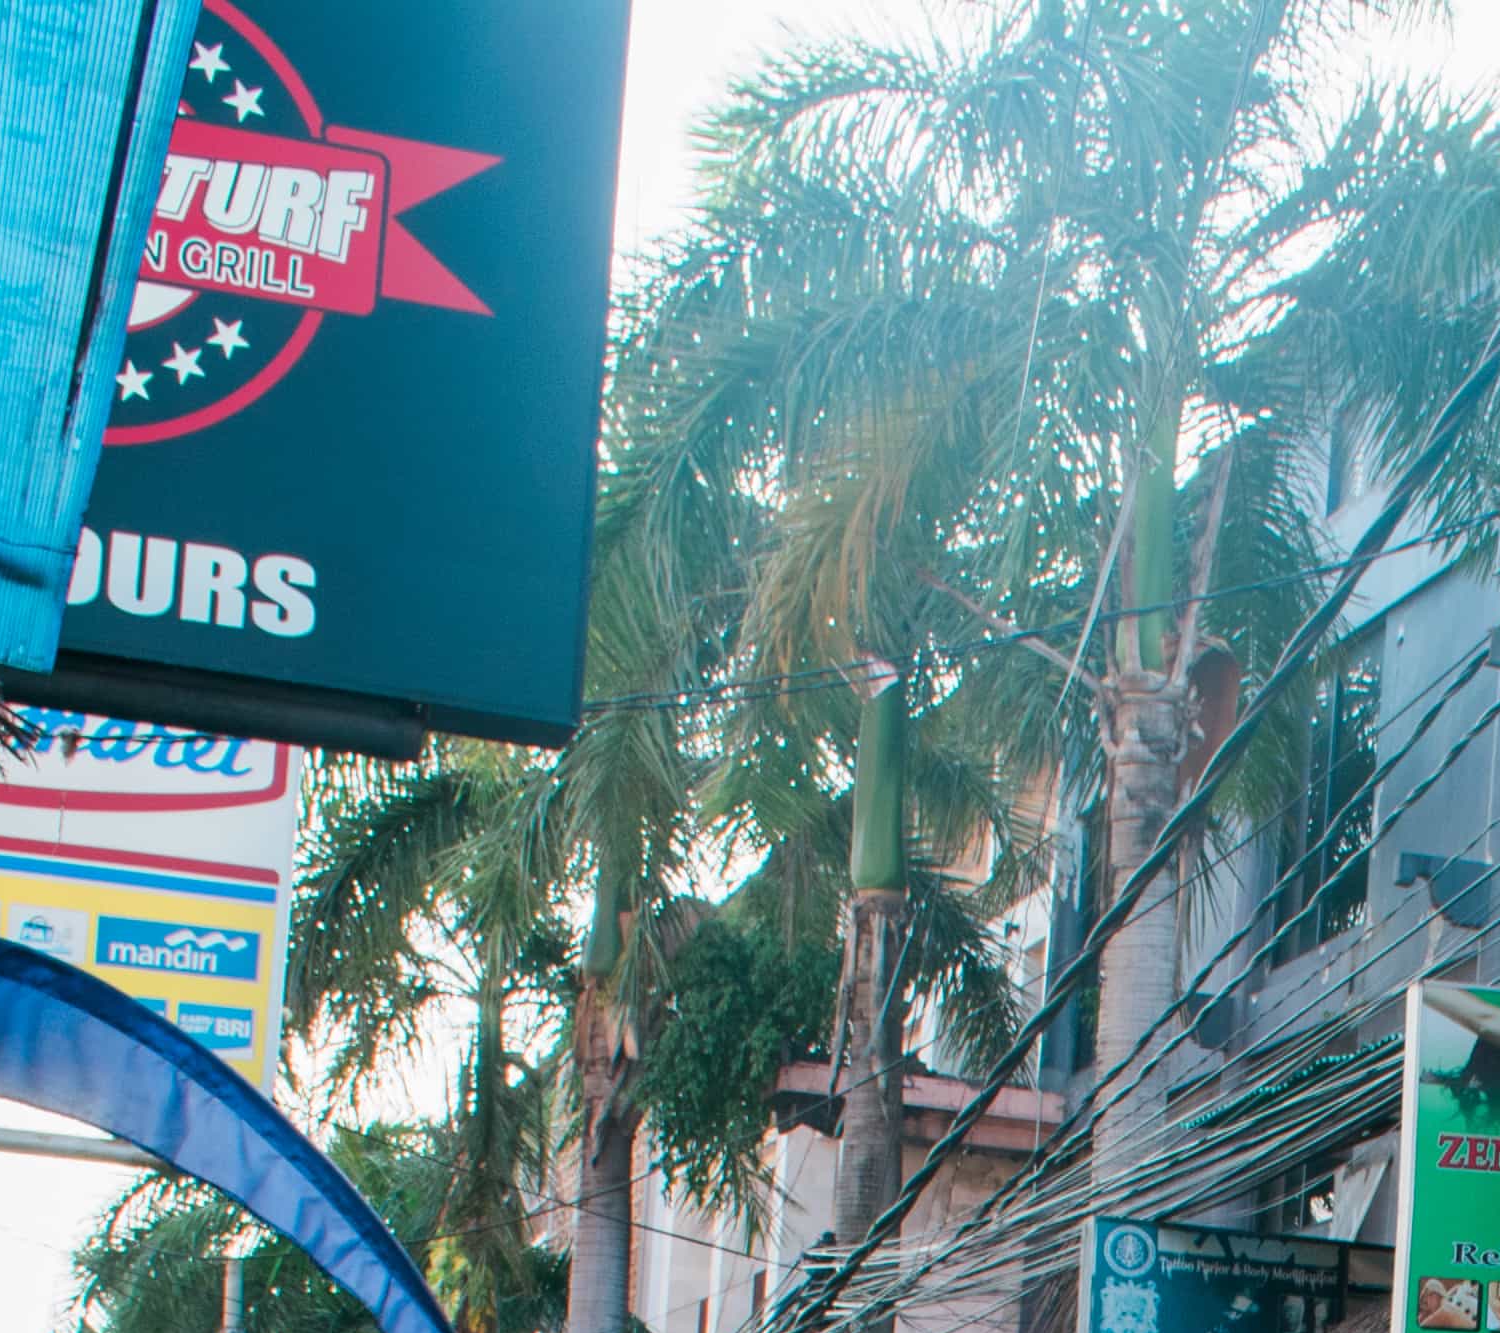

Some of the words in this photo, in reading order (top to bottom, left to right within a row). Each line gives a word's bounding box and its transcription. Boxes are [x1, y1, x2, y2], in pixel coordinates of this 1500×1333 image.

[180, 238, 316, 302] GRILL
[108, 940, 218, 973] mandiri
[214, 1019, 250, 1039] BRI
